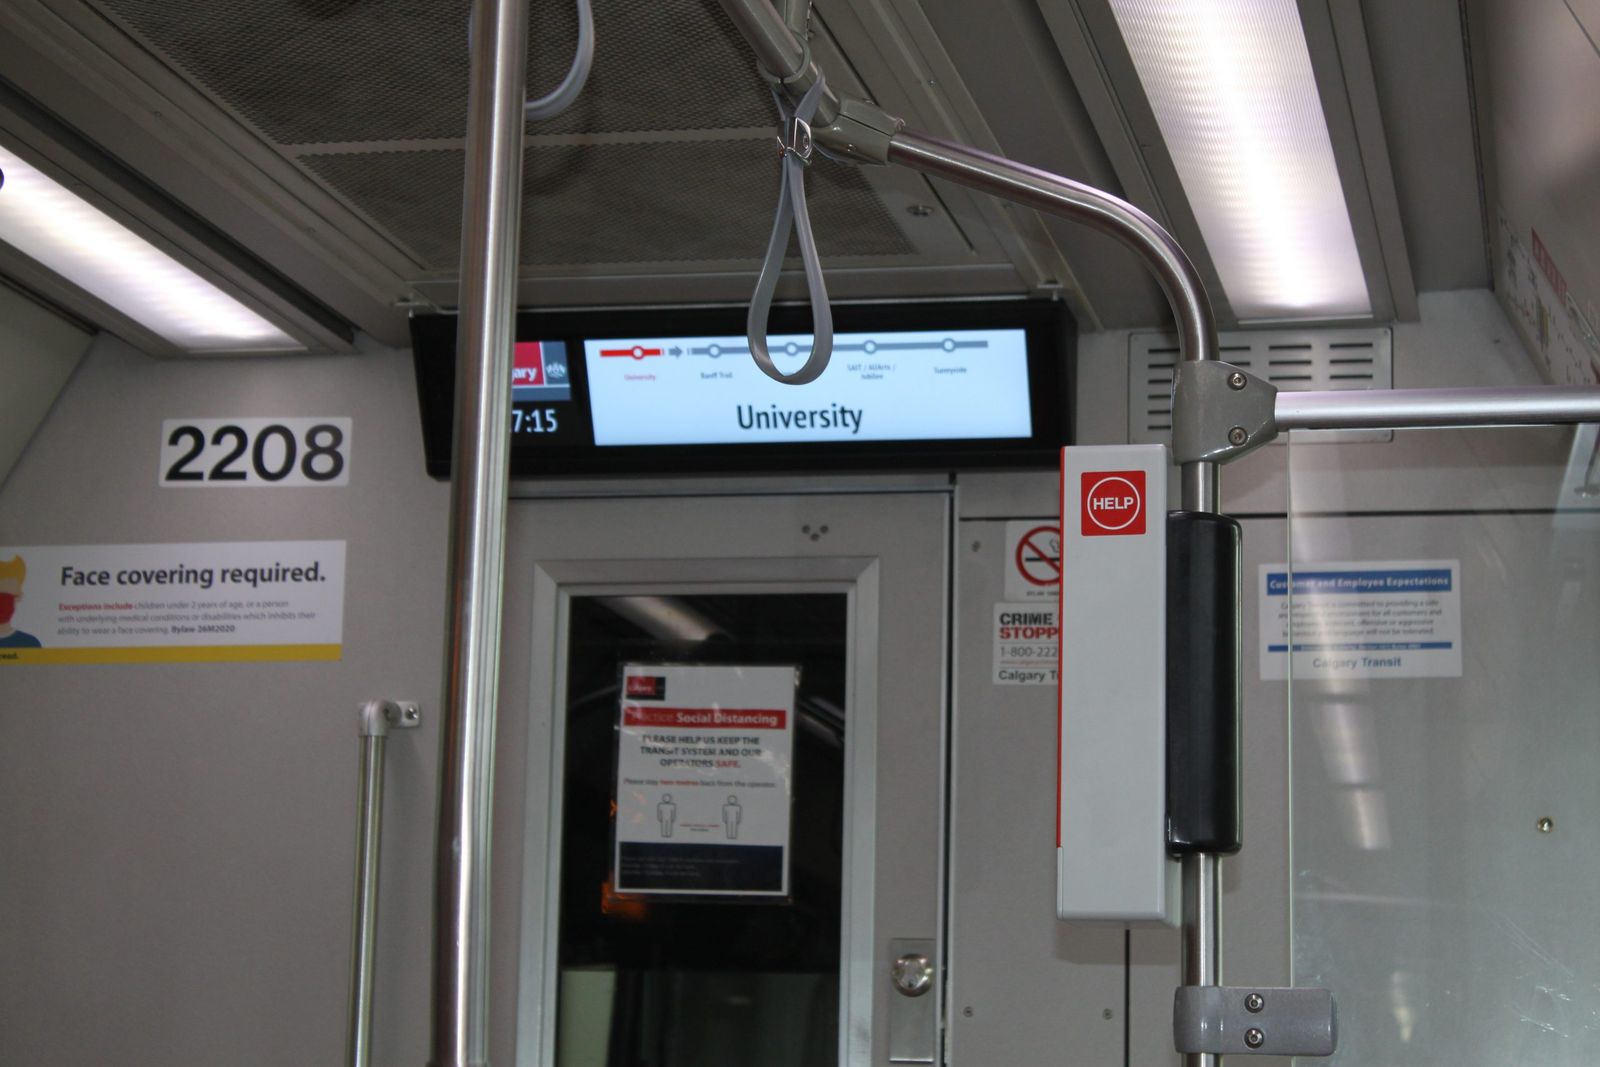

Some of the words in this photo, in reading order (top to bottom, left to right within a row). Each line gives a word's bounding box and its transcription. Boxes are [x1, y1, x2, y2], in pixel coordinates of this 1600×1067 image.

[511, 408, 558, 432] 7:15
[737, 403, 862, 434] University
[165, 424, 344, 481] 2208
[1093, 497, 1134, 510] HELP
[61, 566, 110, 586] Face
[117, 564, 214, 588] covering
[220, 561, 326, 587] required.
[1337, 577, 1384, 589] Employee
[1386, 576, 1449, 587] Expectations
[59, 602, 101, 612] Exceptions
[103, 602, 133, 611] include
[999, 612, 1053, 625] CRIME
[171, 625, 195, 635] Bylaw
[999, 626, 1058, 639] STOPP
[1001, 646, 1058, 657] 1-800-222
[1362, 657, 1402, 667] Transit
[998, 670, 1045, 682] Calgary
[676, 712, 711, 724] Social
[713, 713, 778, 726] Distancing
[678, 735, 702, 744] HELP
[703, 736, 715, 744] US
[717, 736, 740, 745] KEEP
[742, 736, 760, 745] THE
[680, 746, 717, 756] SYSTEM
[718, 747, 738, 756] AND
[740, 747, 761, 757] OUR
